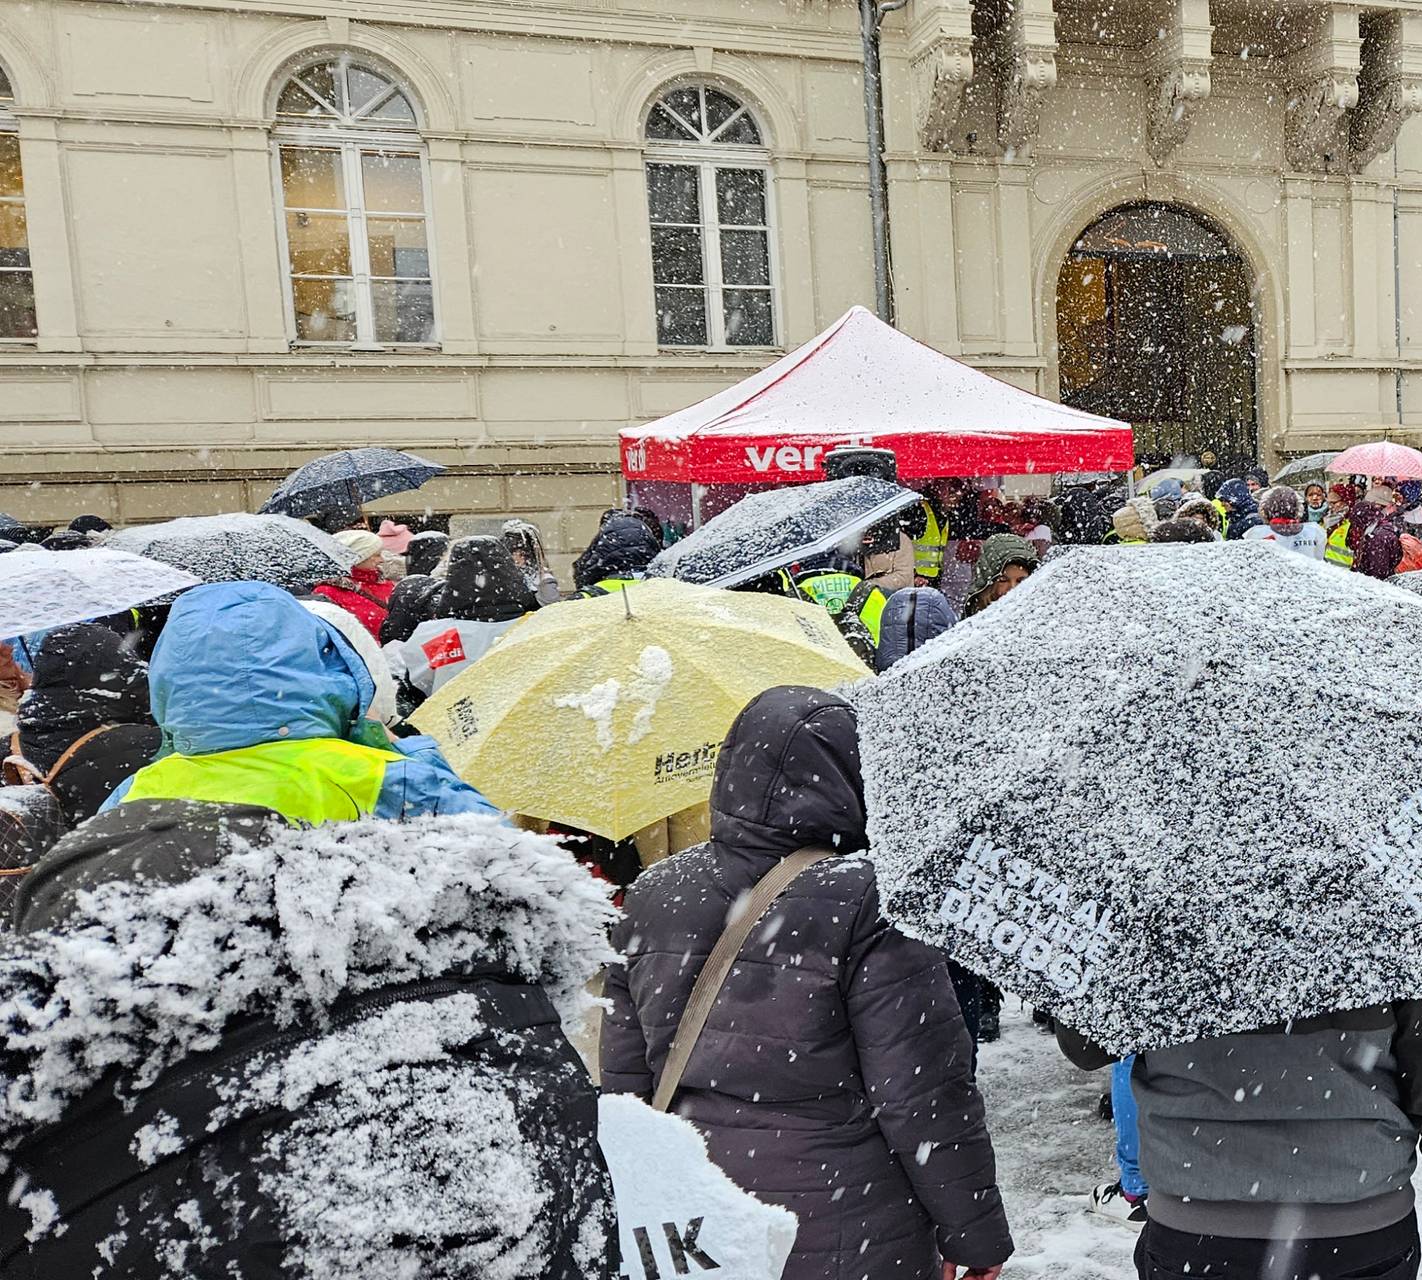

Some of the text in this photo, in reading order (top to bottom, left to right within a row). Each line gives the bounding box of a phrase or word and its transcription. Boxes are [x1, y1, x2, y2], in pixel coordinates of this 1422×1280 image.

[654, 741, 724, 776] Hert
[955, 861, 1011, 911] EEN
[965, 834, 1117, 943] IK STA AL
